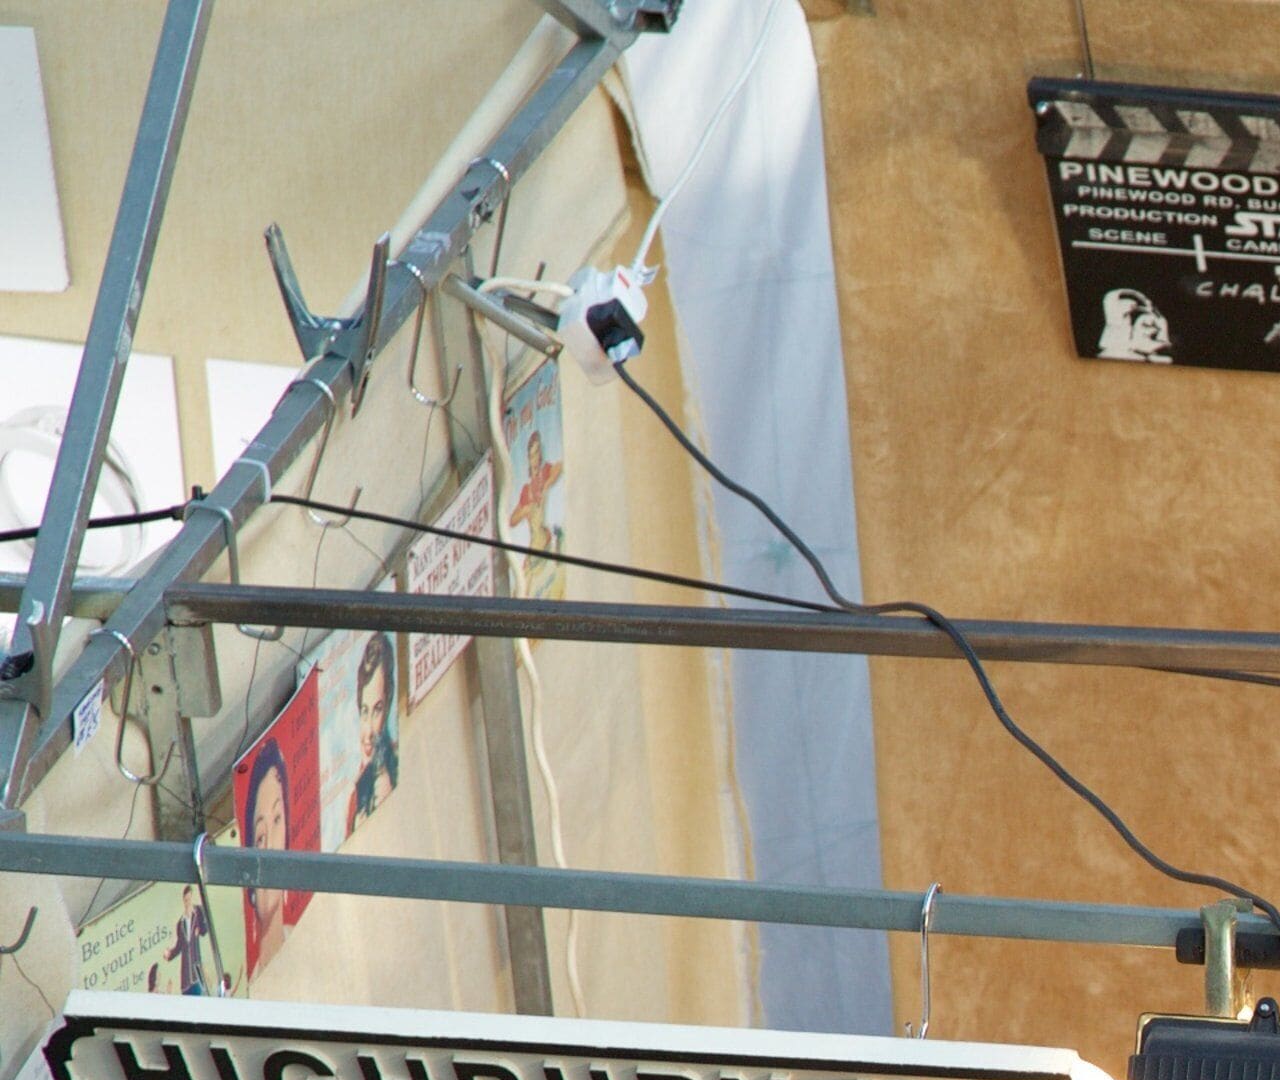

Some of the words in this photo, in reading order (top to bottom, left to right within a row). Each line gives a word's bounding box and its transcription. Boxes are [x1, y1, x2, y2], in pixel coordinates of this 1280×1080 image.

[1060, 162, 1280, 195] PINEWOOD
[1077, 185, 1197, 207] PINEWOOD
[1062, 204, 1218, 227] PRODUCTION
[1088, 228, 1167, 245] SCENE
[81, 942, 100, 962] Be
[105, 918, 134, 947] nice
[83, 973, 98, 990] to
[101, 949, 134, 984] your
